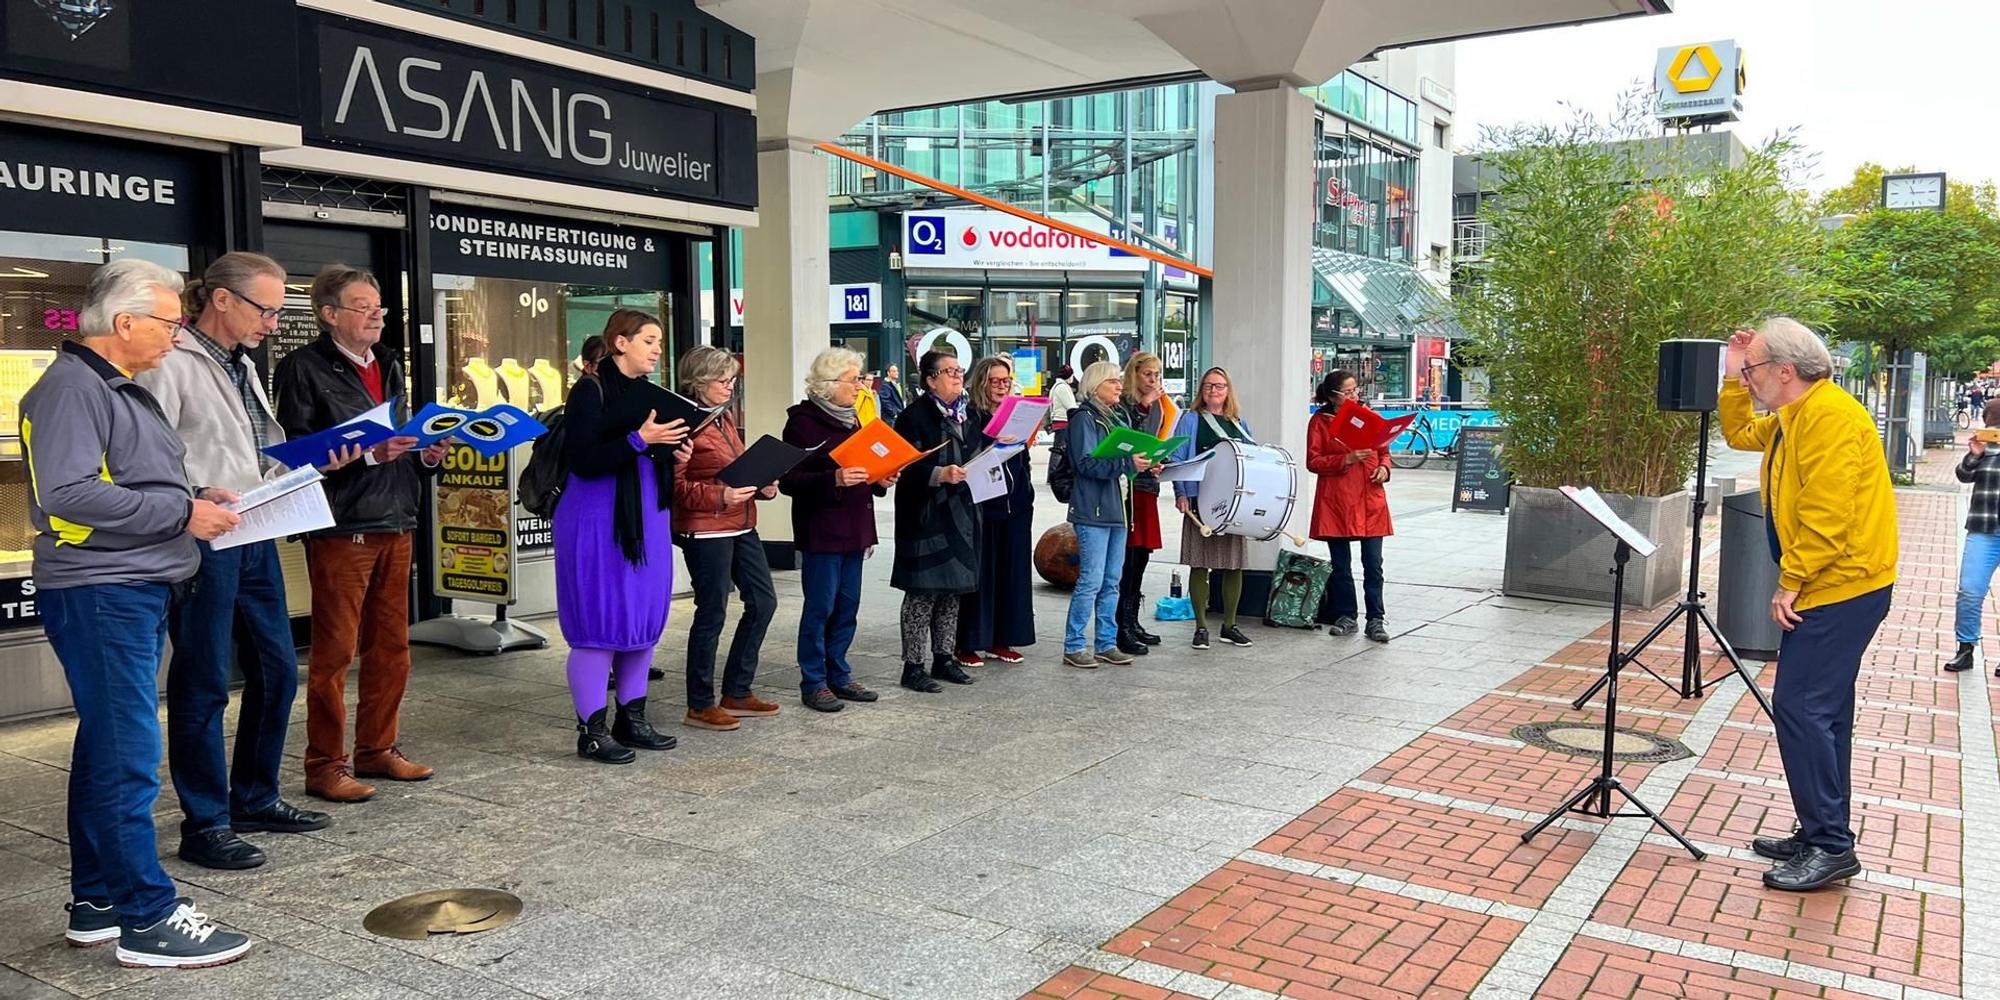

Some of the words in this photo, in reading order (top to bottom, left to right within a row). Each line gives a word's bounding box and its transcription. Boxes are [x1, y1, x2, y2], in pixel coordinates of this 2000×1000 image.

[335, 46, 612, 165] ASANG
[618, 142, 711, 182] Juwelier
[459, 238, 627, 269] STEINFASSUNGEN
[643, 237, 655, 252] &
[846, 295, 867, 311] 1&1
[1164, 342, 1184, 369] 1&1
[442, 445, 505, 472] GOLD
[442, 472, 504, 487] ANKAUF
